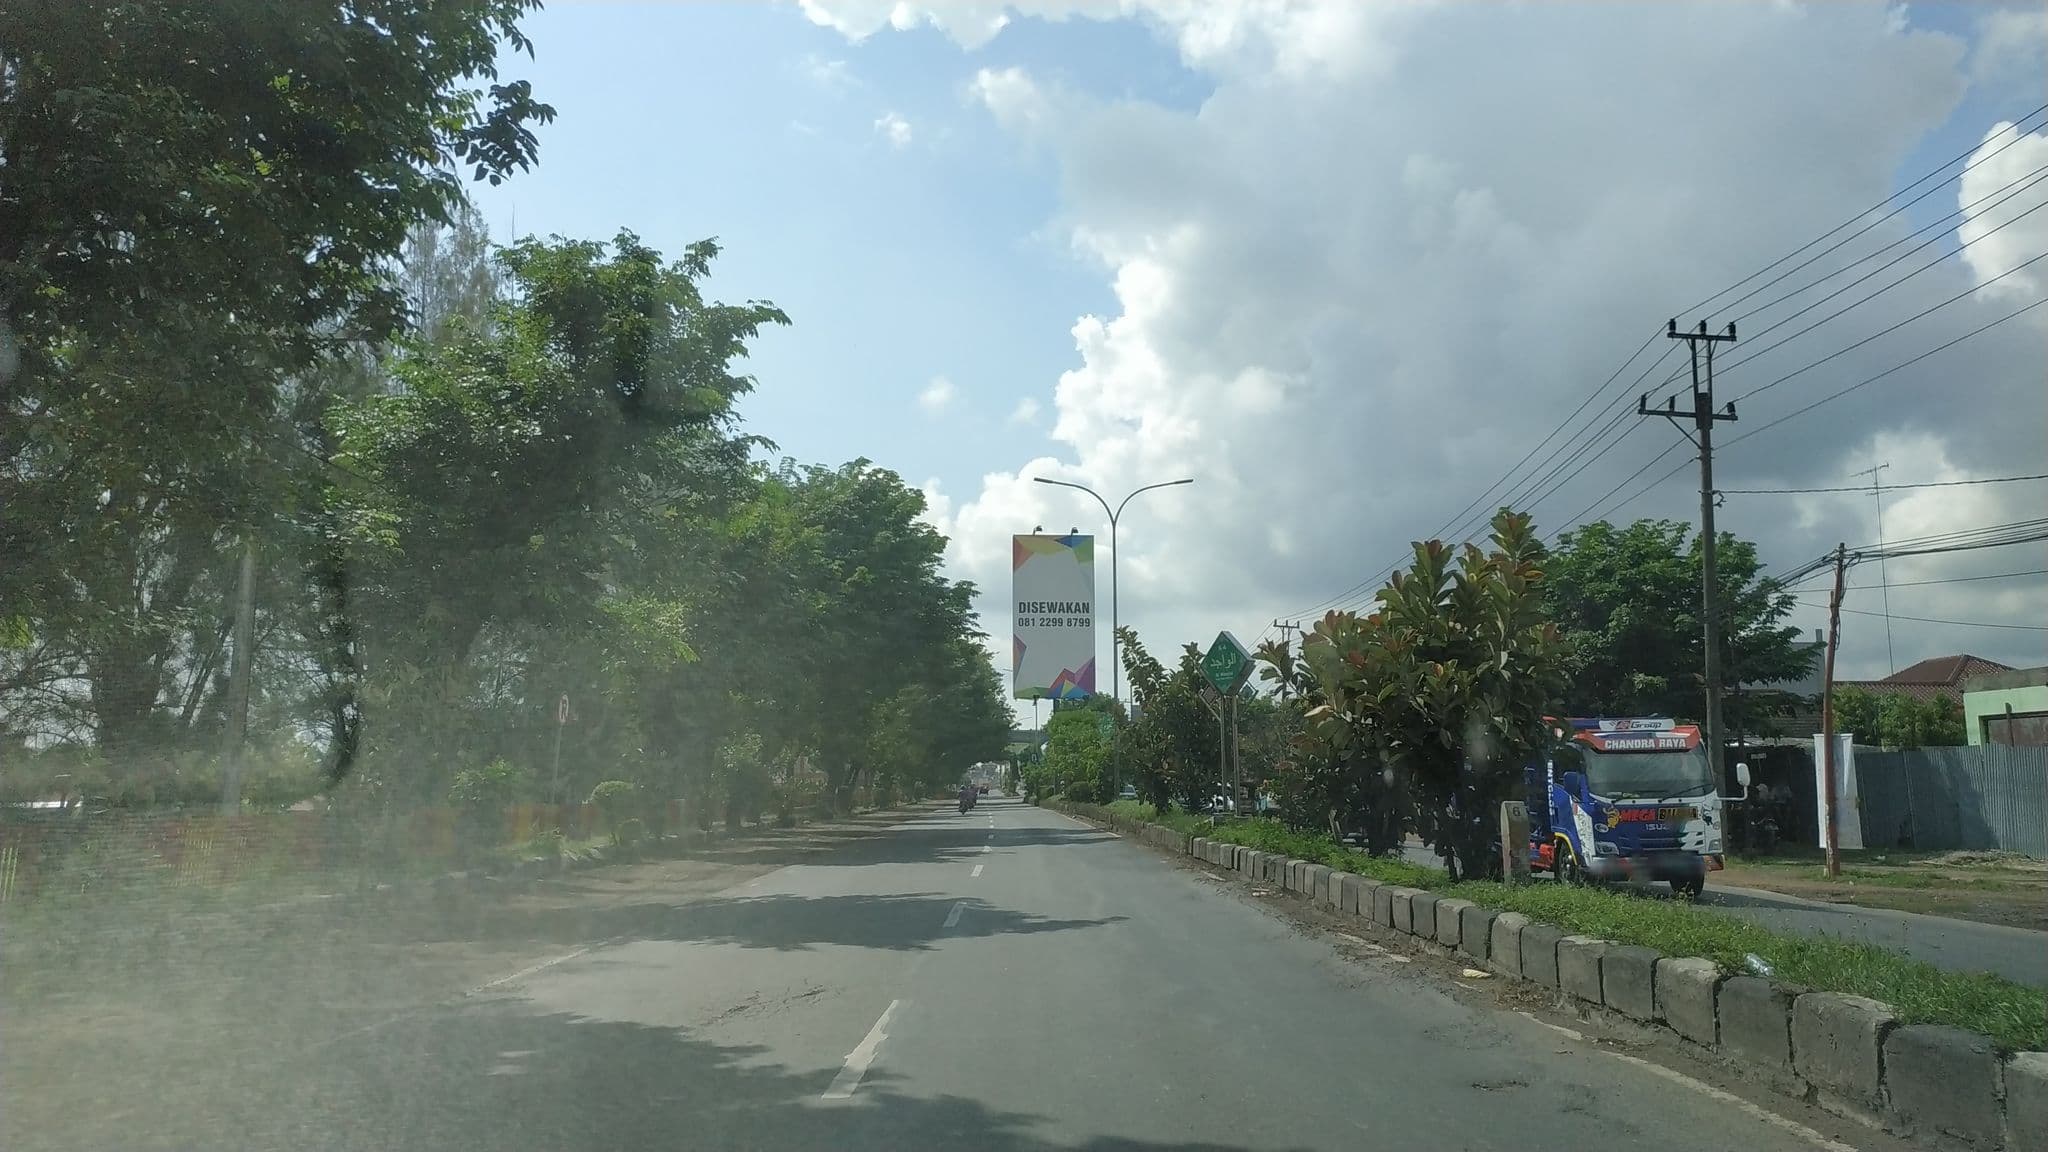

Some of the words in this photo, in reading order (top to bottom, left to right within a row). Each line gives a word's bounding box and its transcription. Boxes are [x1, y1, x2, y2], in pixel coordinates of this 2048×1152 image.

[1018, 601, 1090, 614] DISEWAKAN
[1018, 617, 1036, 627] 081
[1039, 617, 1064, 627] 2299
[1066, 617, 1091, 627] 8799
[1630, 720, 1662, 729] Group
[1604, 738, 1655, 750] CHANDRA
[1658, 738, 1687, 749] RAYA
